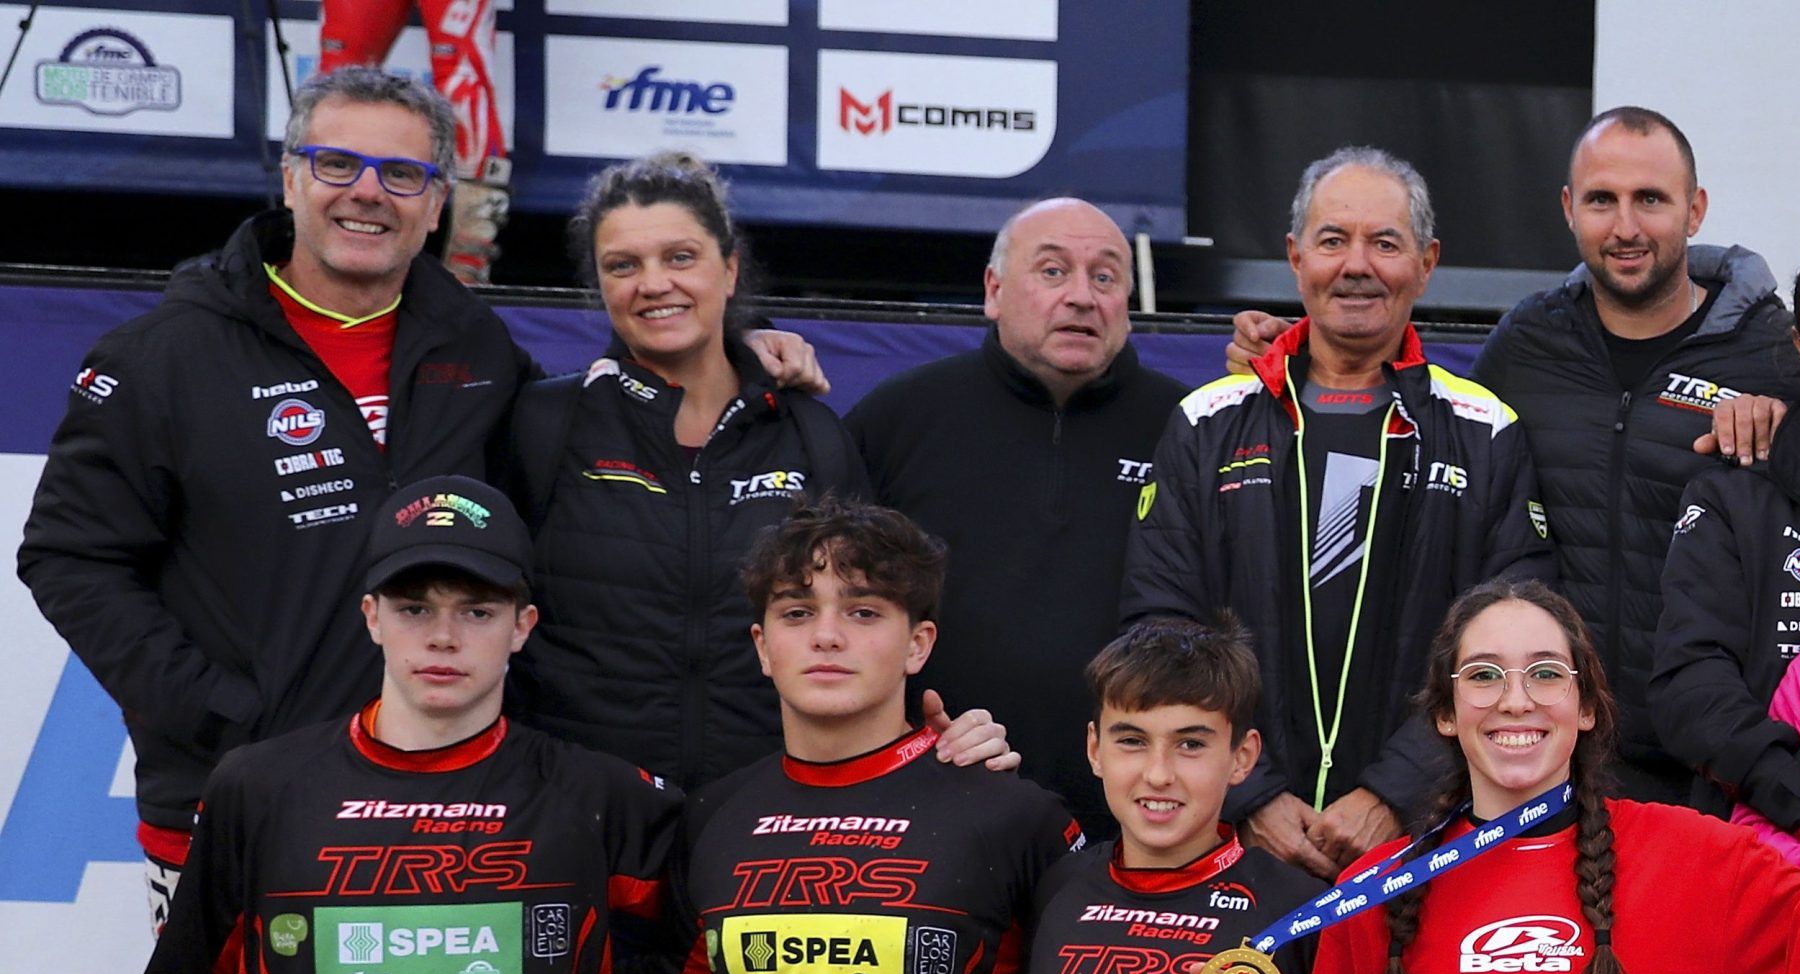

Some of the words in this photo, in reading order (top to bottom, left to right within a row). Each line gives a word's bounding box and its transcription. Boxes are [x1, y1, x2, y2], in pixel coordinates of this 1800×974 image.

[603, 65, 737, 116] rfme
[898, 104, 1037, 132] COMAS
[252, 379, 320, 400] hebo
[1316, 393, 1374, 405] MOTS
[269, 411, 324, 435] NILS
[295, 478, 355, 500] DISHECO
[287, 503, 359, 524] TECH
[336, 799, 508, 820] Zitzmann
[1518, 802, 1548, 827] rfme
[752, 814, 910, 836] Zitzmann
[809, 830, 903, 850] Racing
[1473, 825, 1505, 849] rfme
[1428, 848, 1460, 872] rfme
[1382, 872, 1414, 895] rfme
[1209, 890, 1250, 911] fcm
[1335, 894, 1368, 917] rfme
[1080, 904, 1220, 931] Zitzmann
[1288, 914, 1322, 937] rfme
[388, 926, 500, 957] SPEA
[1127, 923, 1213, 945] Racing
[782, 937, 879, 967] SPEA
[1458, 952, 1572, 974] Beta
